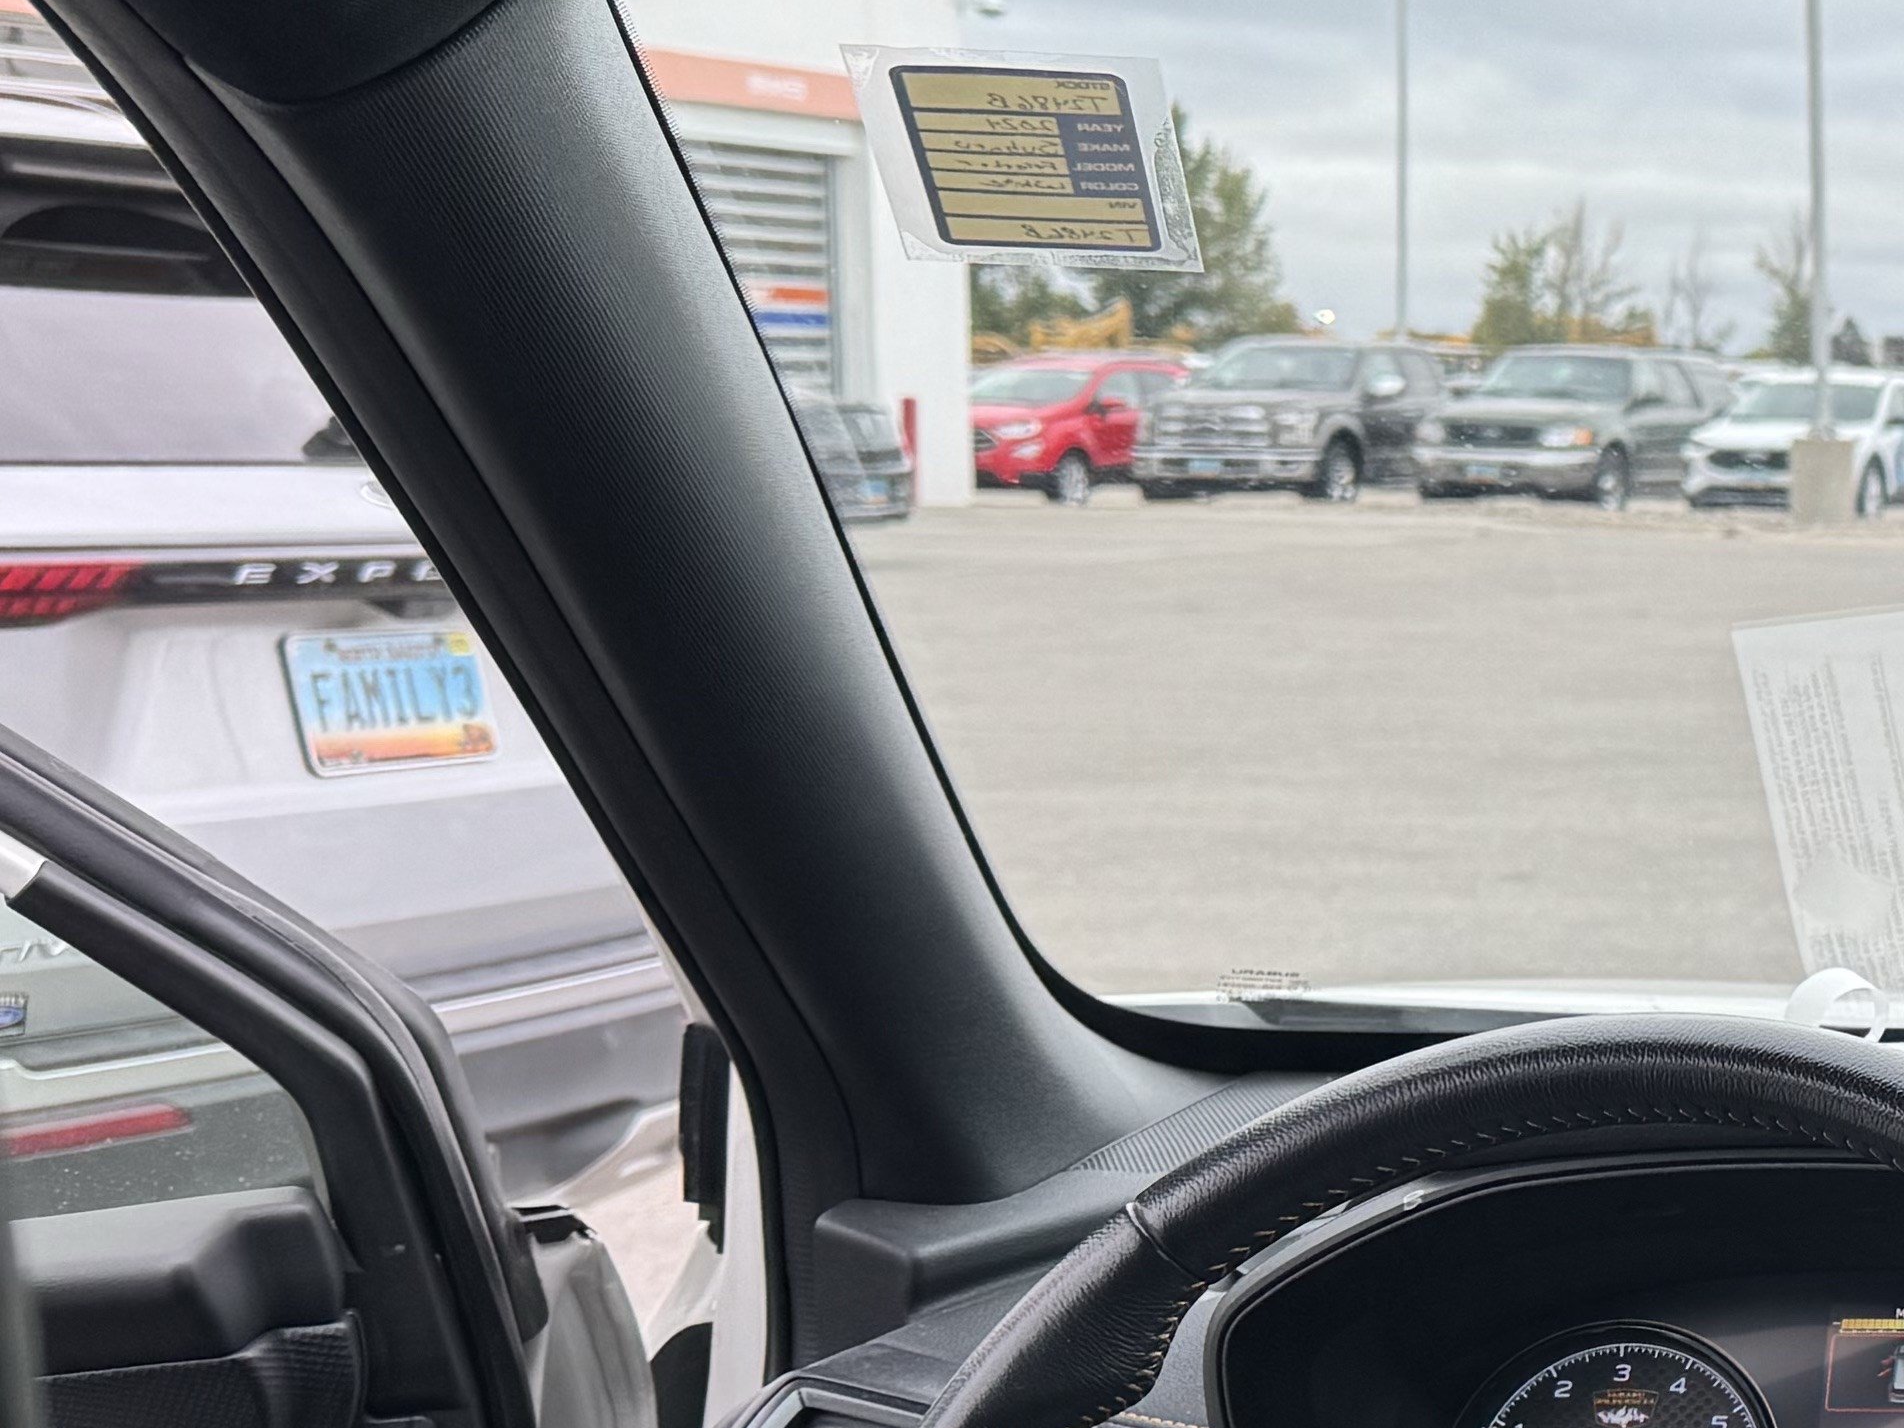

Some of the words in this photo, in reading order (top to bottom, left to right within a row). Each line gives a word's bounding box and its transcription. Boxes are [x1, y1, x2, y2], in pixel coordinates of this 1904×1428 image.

[1613, 1363, 1631, 1382] 3
[1554, 1380, 1573, 1399] 2
[1669, 1376, 1687, 1395] 4
